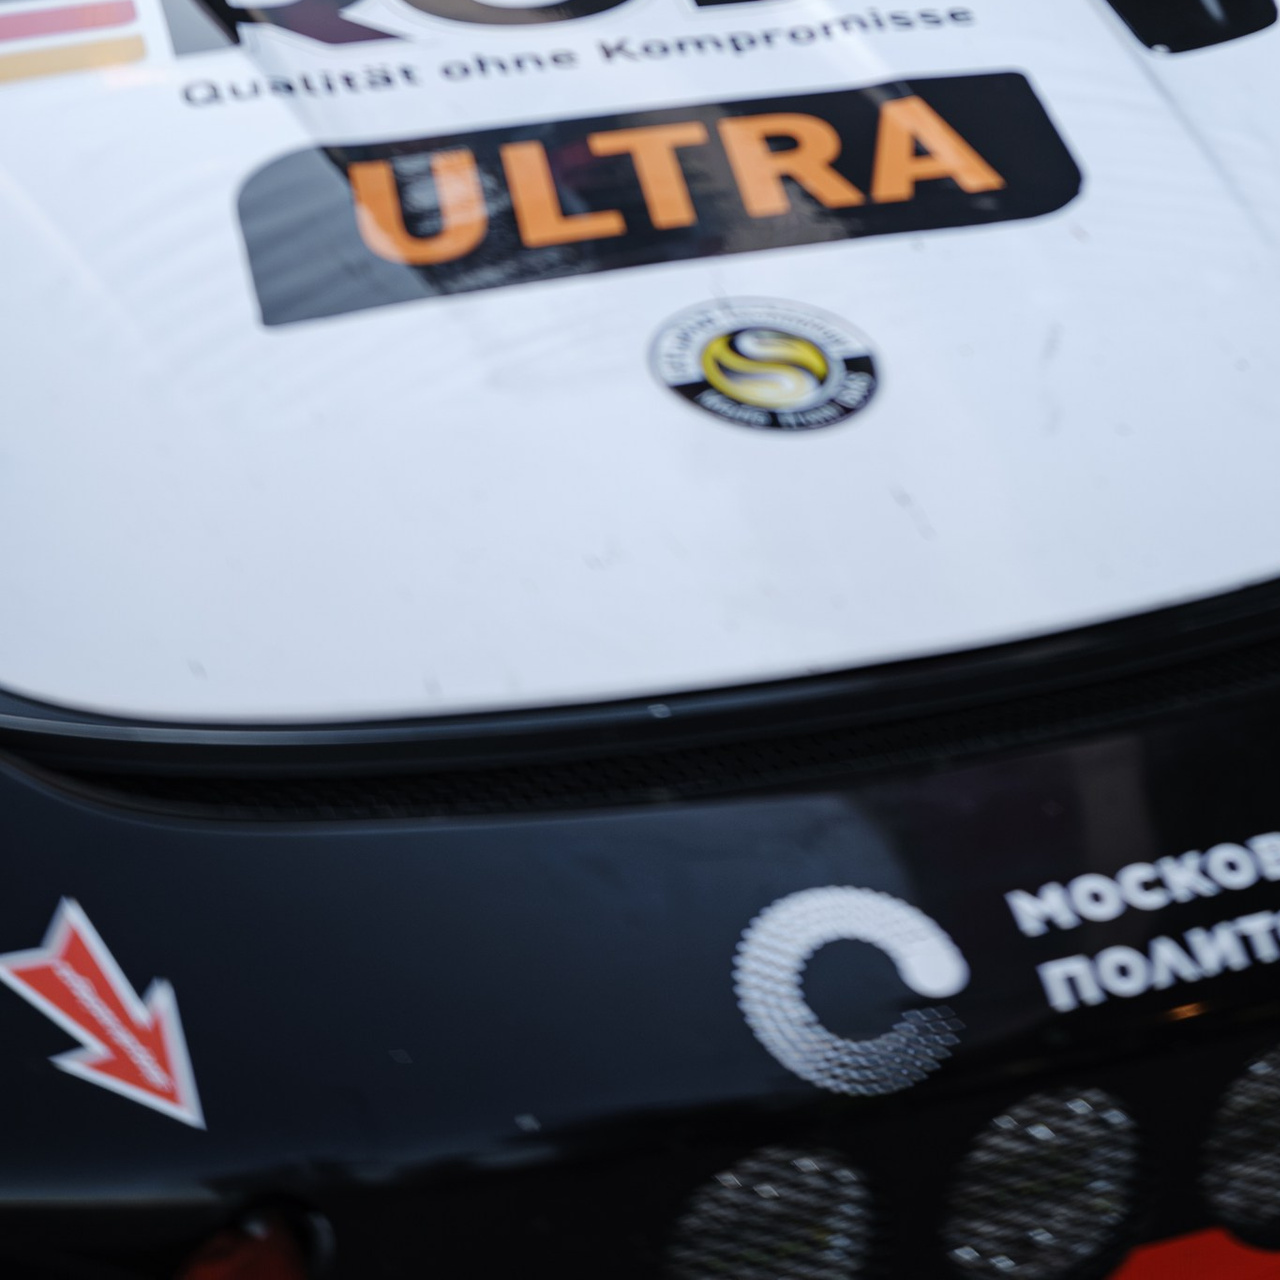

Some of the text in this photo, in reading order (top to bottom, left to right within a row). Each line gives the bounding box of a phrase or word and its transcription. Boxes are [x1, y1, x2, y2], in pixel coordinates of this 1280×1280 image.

[181, 4, 976, 108] Qualität ohne Kompromisse
[347, 95, 1005, 265] ULTRA
